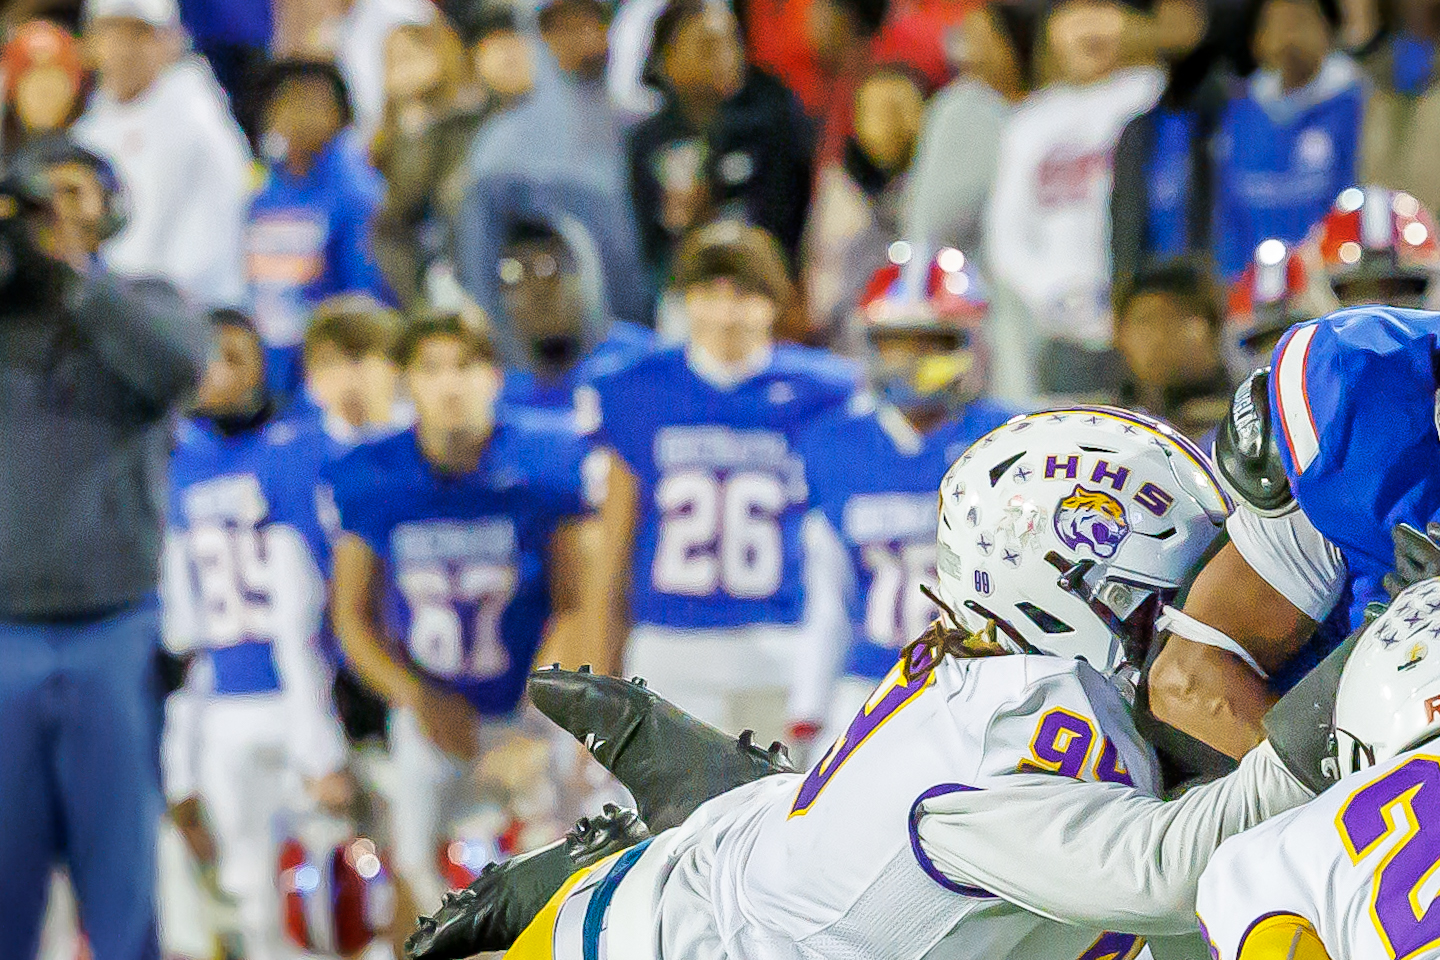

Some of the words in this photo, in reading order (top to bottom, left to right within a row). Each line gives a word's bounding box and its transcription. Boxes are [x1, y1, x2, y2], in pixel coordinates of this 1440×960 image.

[652, 472, 784, 599] 26
[1043, 454, 1175, 518] HHS
[398, 569, 519, 676] 67
